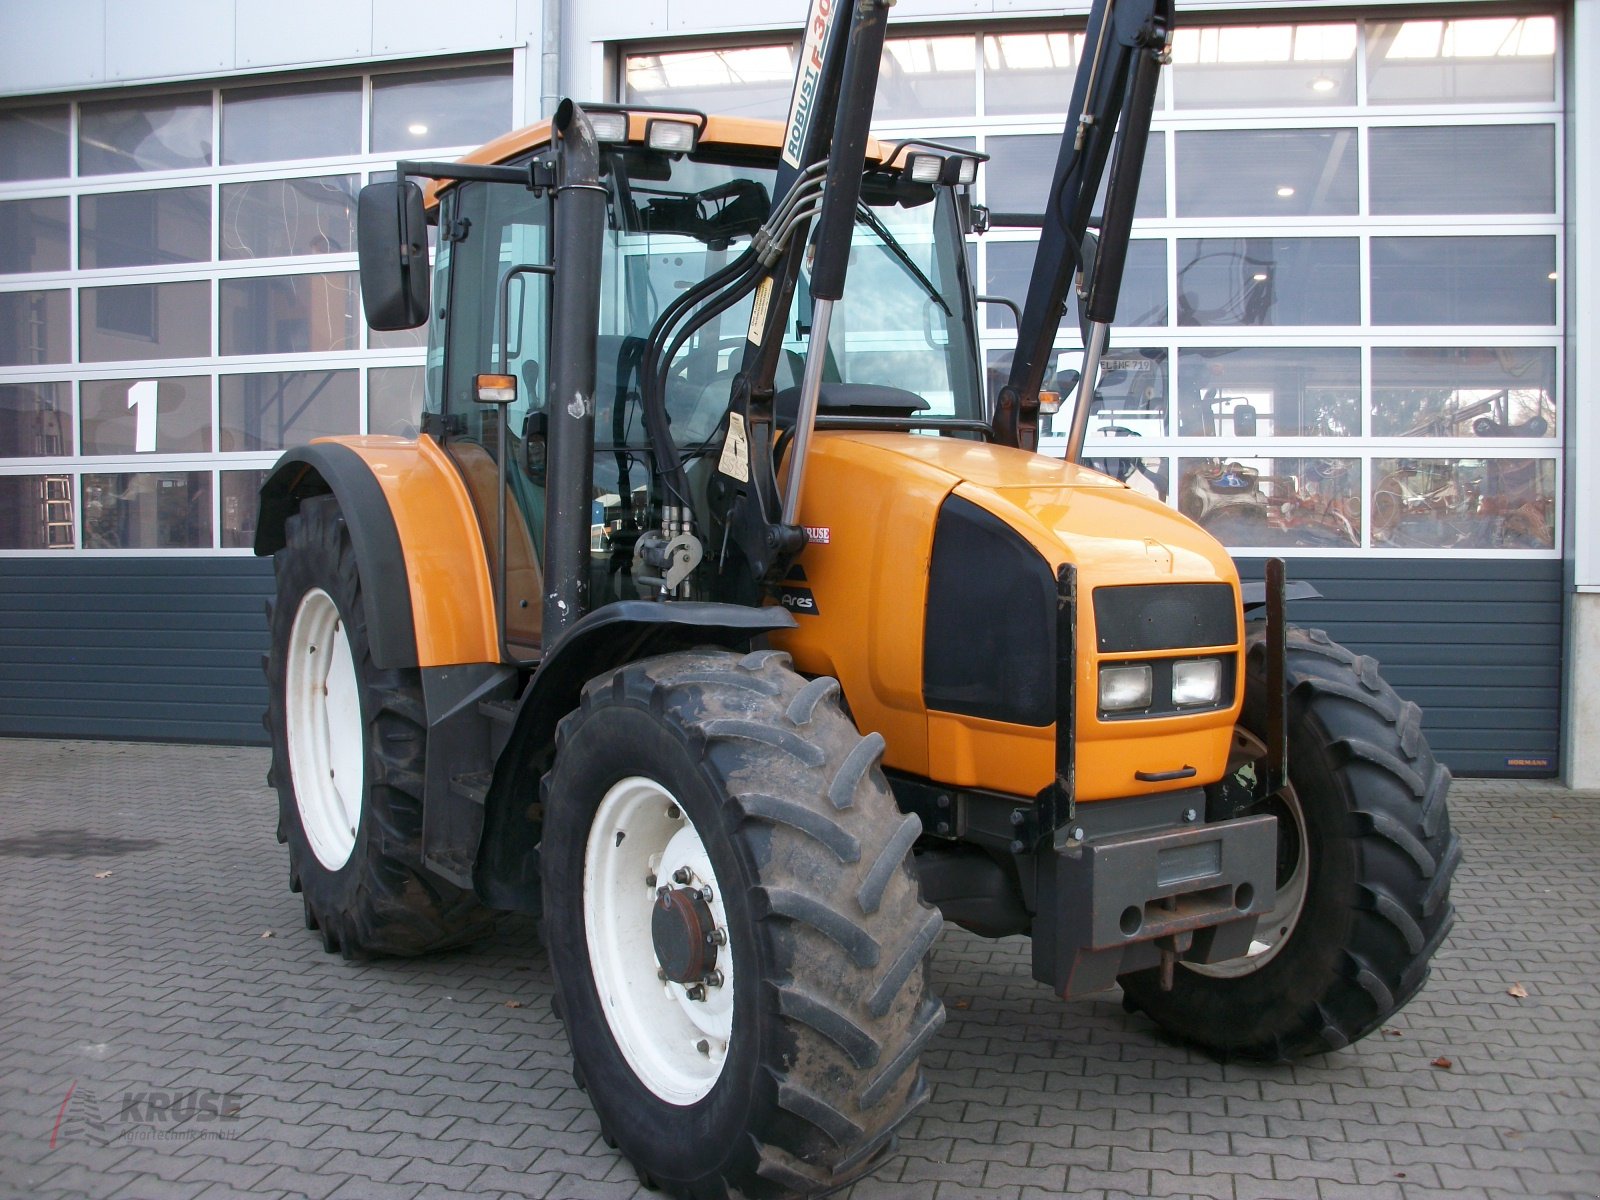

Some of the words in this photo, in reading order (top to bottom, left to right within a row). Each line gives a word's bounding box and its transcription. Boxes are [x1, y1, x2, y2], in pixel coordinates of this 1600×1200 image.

[787, 65, 815, 159] ROBUST
[811, 45, 822, 70] F
[128, 381, 158, 453] 1
[804, 527, 830, 540] RUSE
[782, 594, 813, 608] Ares
